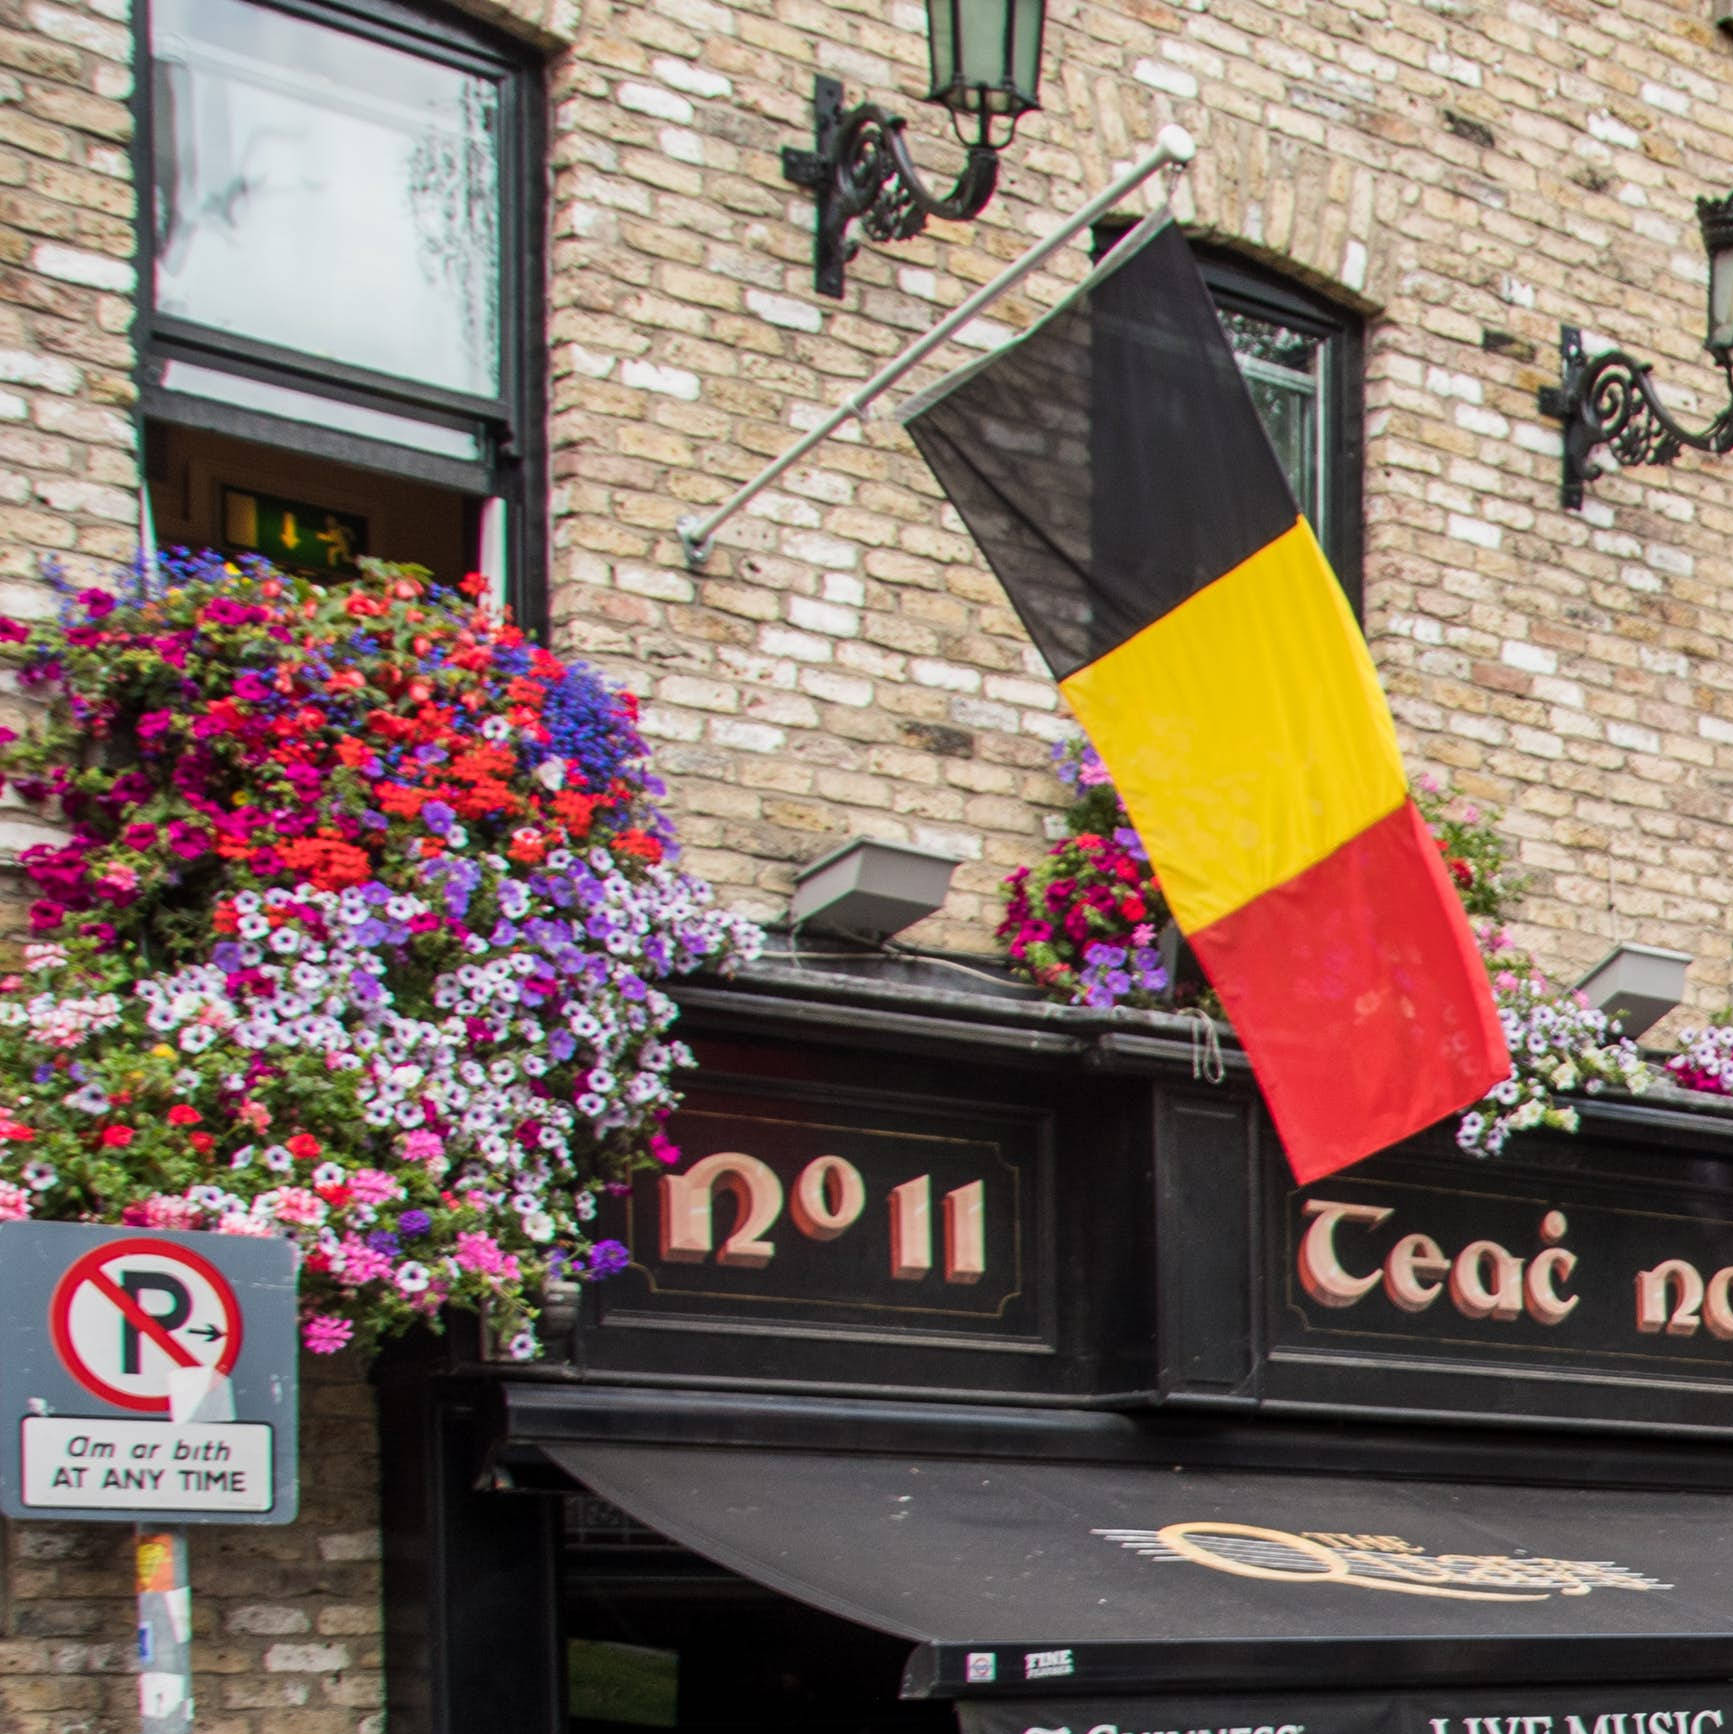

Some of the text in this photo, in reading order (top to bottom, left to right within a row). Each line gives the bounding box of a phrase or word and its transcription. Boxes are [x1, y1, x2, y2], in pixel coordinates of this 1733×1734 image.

[131, 1442, 161, 1459] ar
[52, 1467, 248, 1492] AT ANY TIME
